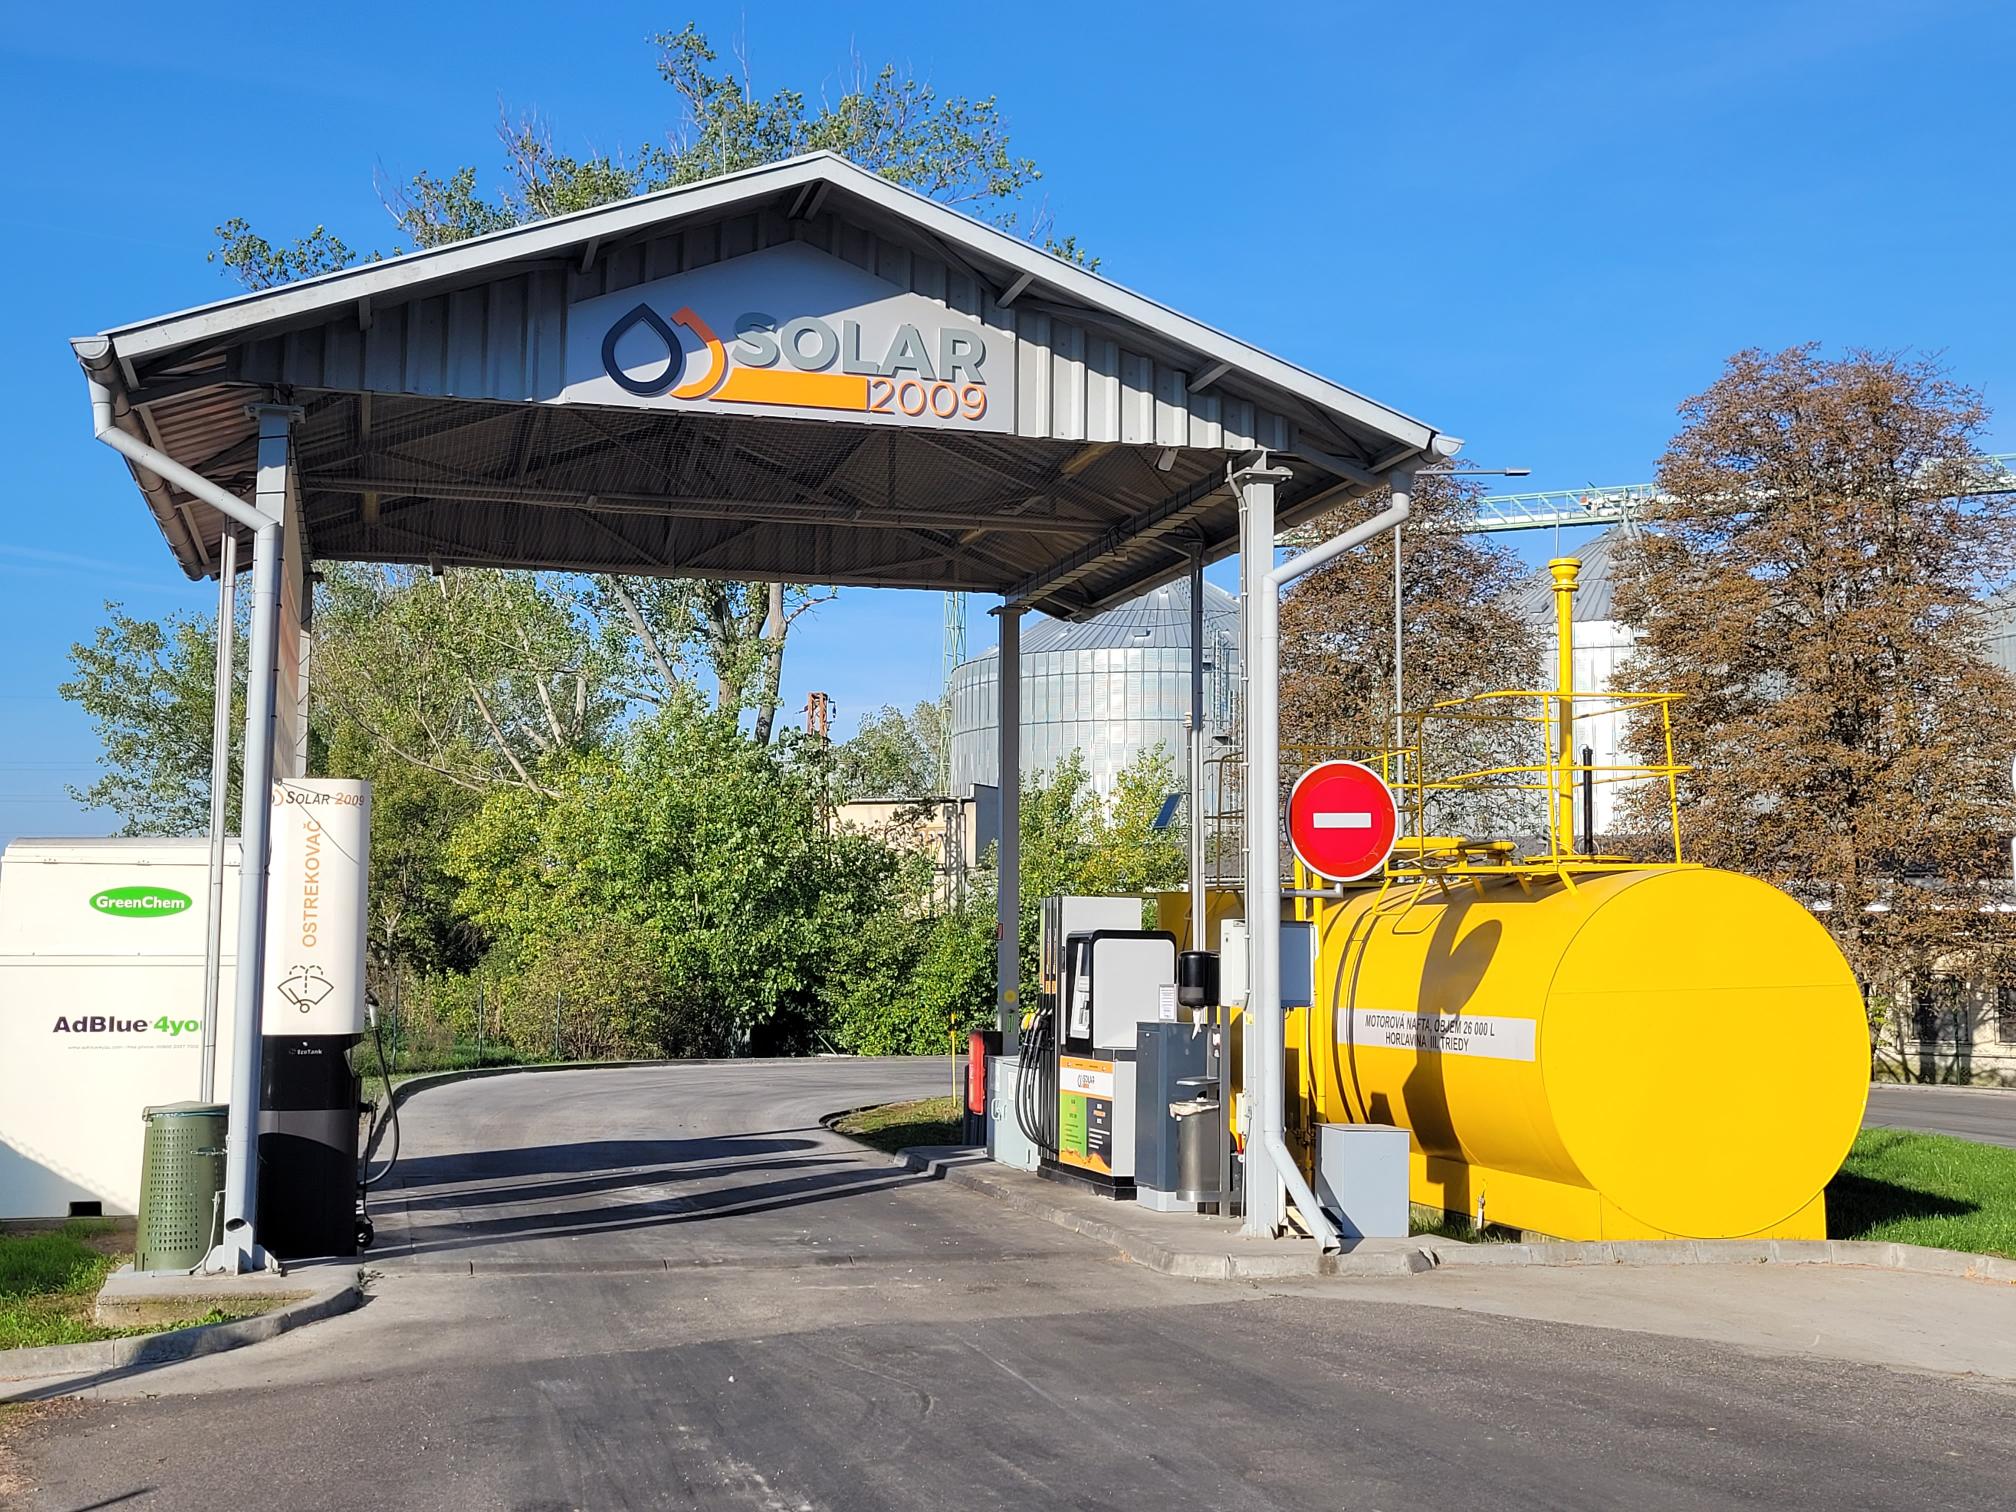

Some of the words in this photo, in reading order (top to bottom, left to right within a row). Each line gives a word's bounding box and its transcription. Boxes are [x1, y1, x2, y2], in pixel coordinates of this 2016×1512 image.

[732, 311, 987, 385] SOLAR
[869, 377, 987, 420] 2009
[286, 791, 330, 805] SOLAR
[335, 792, 365, 806] 2009
[302, 820, 322, 948] OSTREKOVAČ
[96, 896, 185, 909] GreenChem
[1365, 1013, 1405, 1028] MOTOROVÁ
[1407, 1017, 1432, 1034] NAFTA,
[1434, 1018, 1462, 1034] OBJEM
[1463, 1021, 1473, 1035] 26
[1474, 1022, 1488, 1036] 000
[1489, 1023, 1496, 1037] L
[1441, 1037, 1470, 1051] TRIEDY
